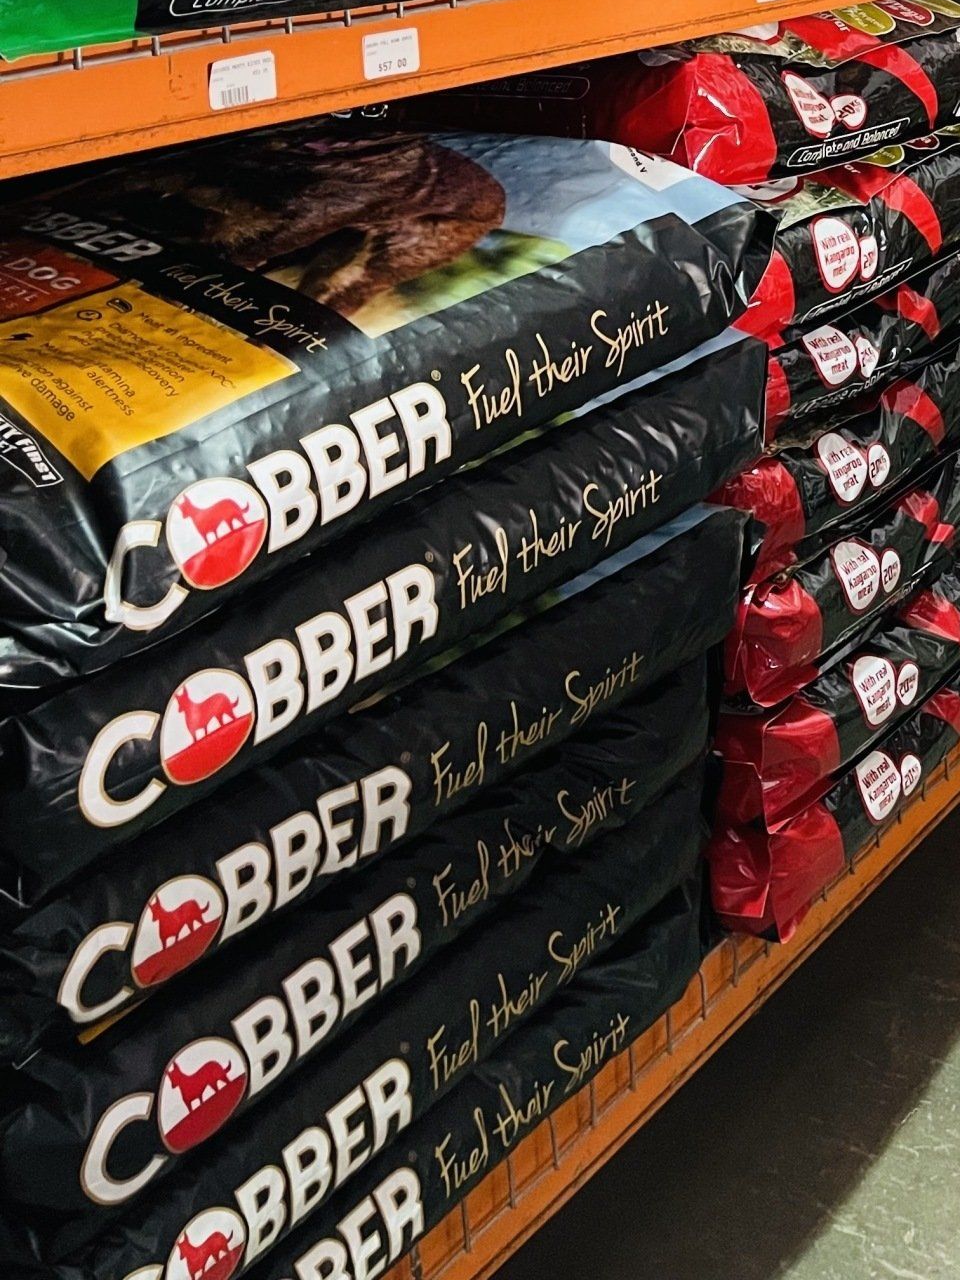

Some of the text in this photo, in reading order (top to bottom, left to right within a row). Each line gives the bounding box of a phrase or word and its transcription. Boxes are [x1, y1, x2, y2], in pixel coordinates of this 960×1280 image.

[377, 61, 393, 73] $57
[860, 121, 901, 147] Balanced
[4, 256, 82, 291] DOG
[836, 230, 851, 248] real
[202, 273, 259, 313] their
[254, 303, 329, 354] Spirit
[29, 376, 77, 424] damage
[49, 372, 95, 414] against
[85, 369, 136, 418] alertness
[460, 299, 670, 431] Fuel their Spirit
[830, 360, 850, 376] meat
[103, 381, 453, 631] COBBER
[452, 469, 664, 610] Fuel their Spirit
[76, 563, 440, 828] COBBER
[858, 662, 889, 694] With real
[430, 651, 645, 807] Fuel their Spirit
[860, 756, 892, 790] With real
[867, 770, 898, 804] Kangaroo
[432, 776, 637, 928] Fuel their Spirit
[57, 764, 414, 1022] COBBER
[426, 903, 622, 1091] Fuel their Spirit
[80, 892, 423, 1205] COBBER
[434, 1011, 631, 1199] Fuel their Spirit
[121, 1057, 414, 1280] OBBER
